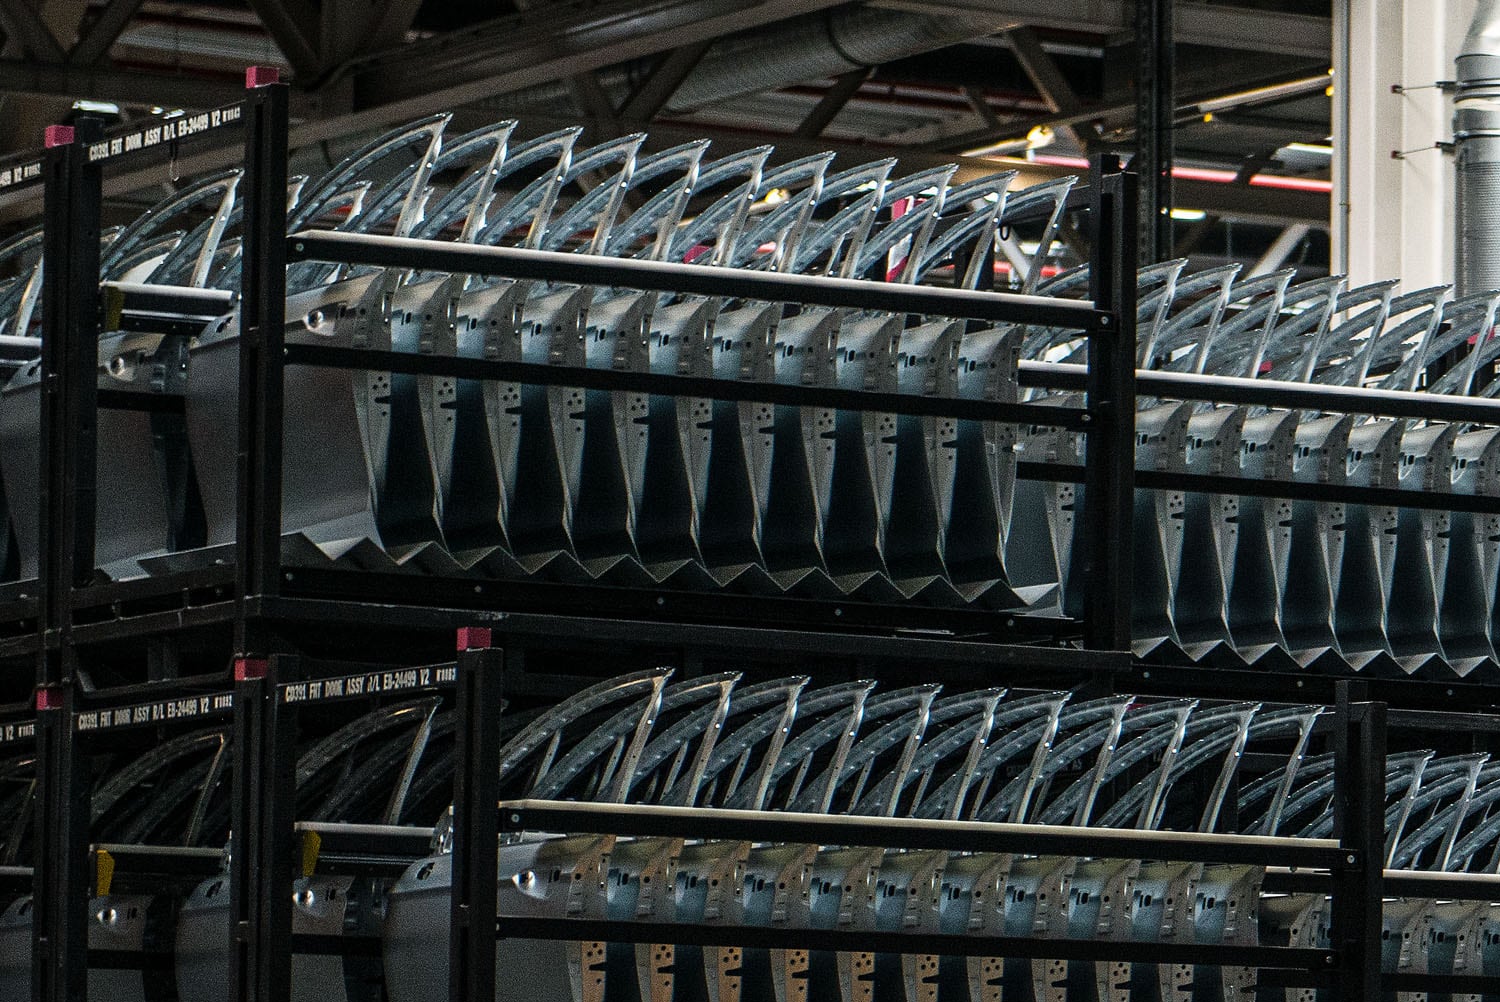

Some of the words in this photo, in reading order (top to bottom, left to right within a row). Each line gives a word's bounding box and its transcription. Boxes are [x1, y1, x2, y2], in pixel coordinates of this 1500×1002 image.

[144, 127, 161, 146] ASSY
[211, 110, 221, 127] V2
[286, 685, 306, 703] CD391
[309, 682, 321, 699] FRT
[325, 680, 343, 697] DOOR
[346, 676, 364, 694] ASSY
[384, 669, 416, 690] EB-24499
[420, 668, 430, 686] V2
[78, 712, 97, 730] CD391
[100, 711, 111, 728] FRT
[114, 709, 131, 726] DOOR
[133, 706, 150, 723] ASSY
[153, 704, 164, 721] R/L
[167, 700, 197, 718] EB-24499
[200, 697, 209, 714] V2
